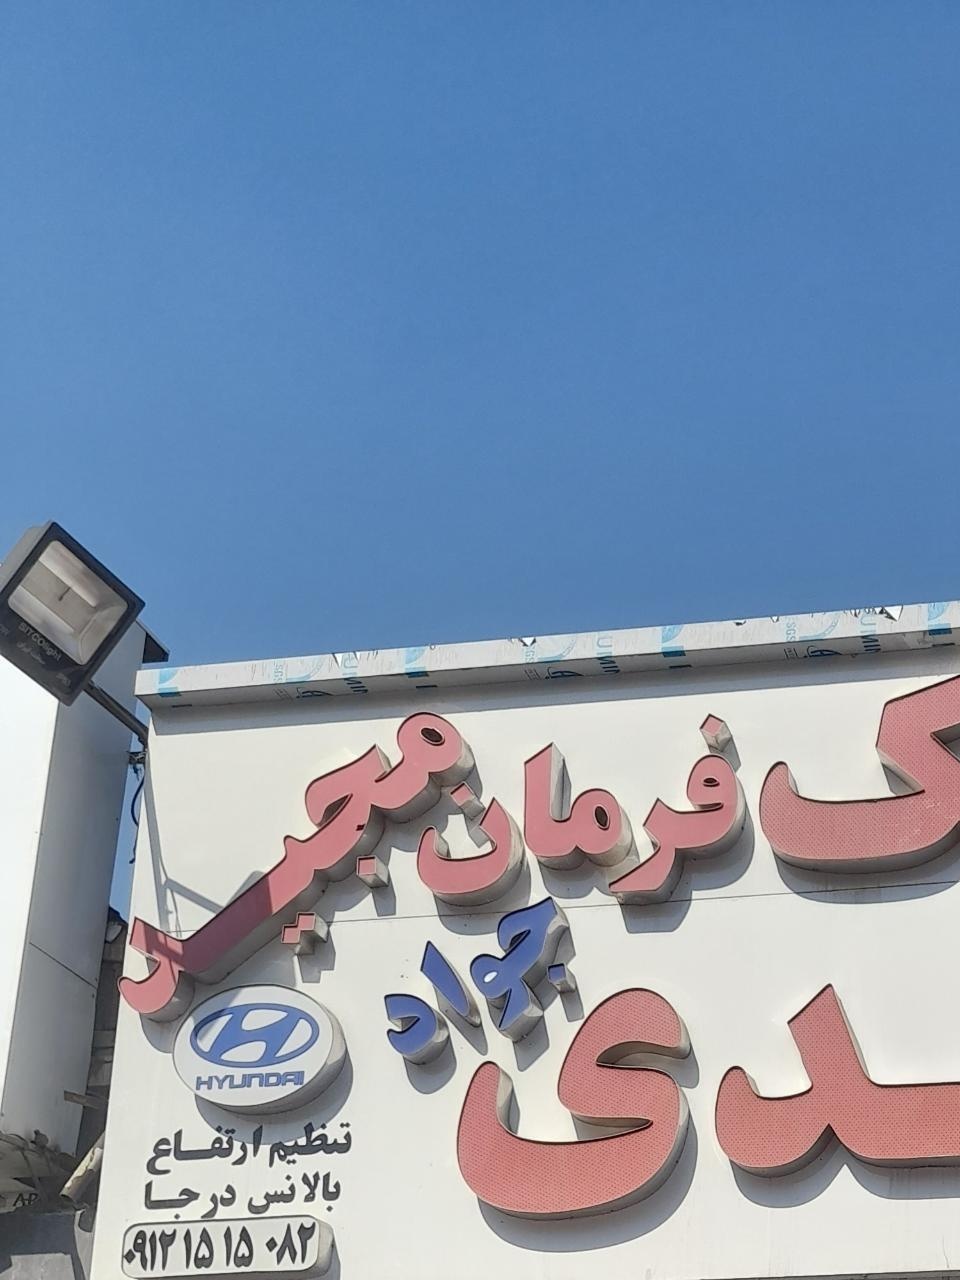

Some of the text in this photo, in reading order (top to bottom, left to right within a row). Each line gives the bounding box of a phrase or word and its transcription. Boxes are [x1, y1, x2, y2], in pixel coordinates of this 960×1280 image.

[416, 712, 742, 908] فرمان
[195, 1070, 305, 1091] HYUNDAI
[146, 1121, 352, 1175] تنظیم ارتفاع
[247, 1171, 341, 1214] بالانس
